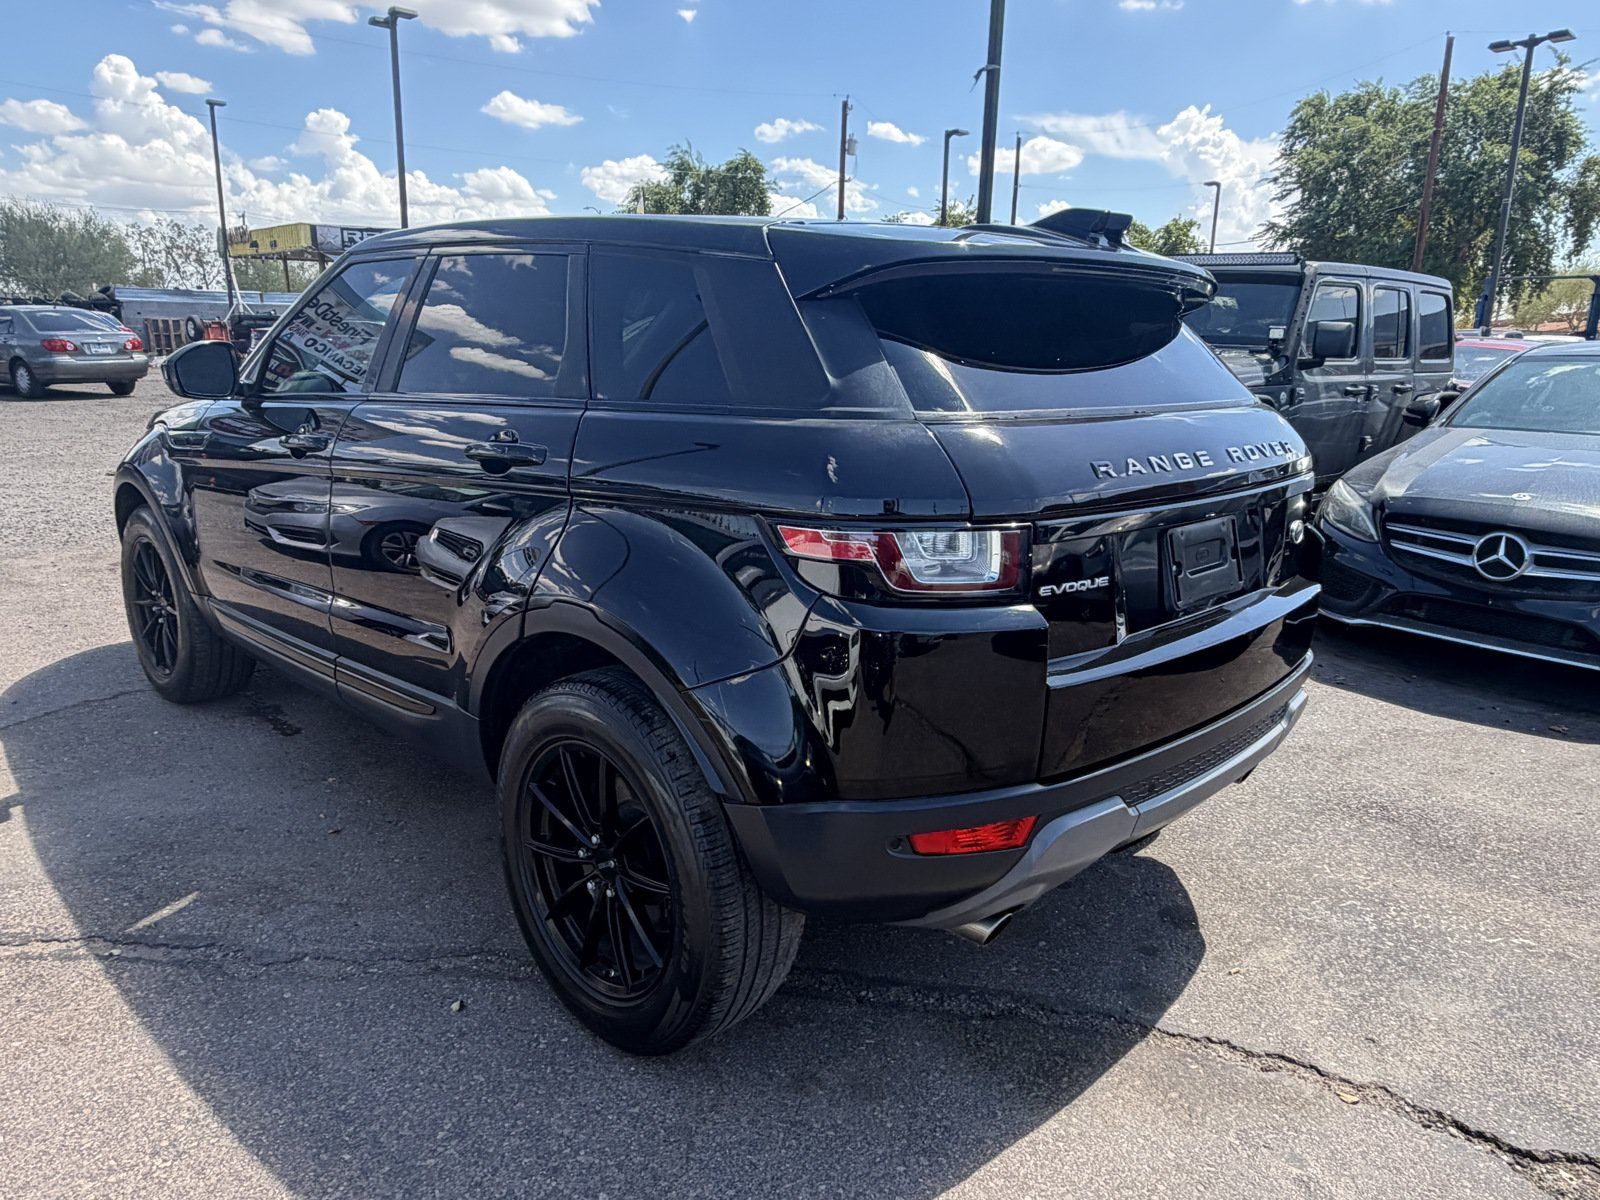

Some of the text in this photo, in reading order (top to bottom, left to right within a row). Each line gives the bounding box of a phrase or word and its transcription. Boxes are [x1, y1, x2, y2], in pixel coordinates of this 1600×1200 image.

[1089, 440, 1295, 479] RANGE ROVER
[1039, 576, 1109, 596] EVOQUE
